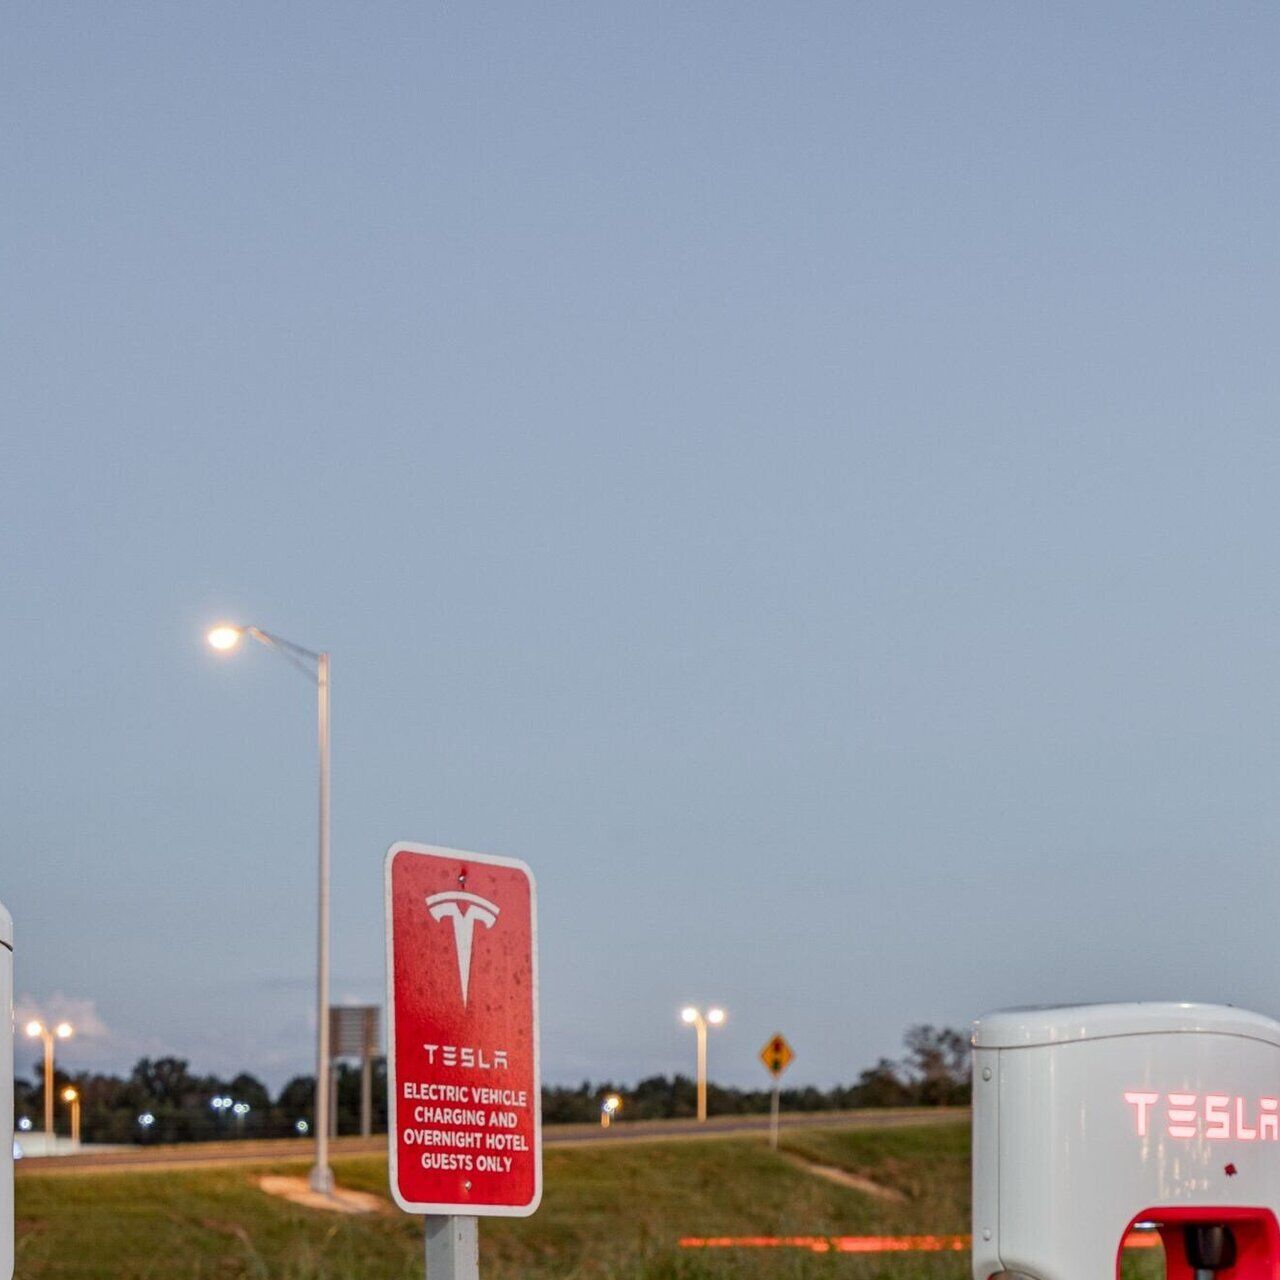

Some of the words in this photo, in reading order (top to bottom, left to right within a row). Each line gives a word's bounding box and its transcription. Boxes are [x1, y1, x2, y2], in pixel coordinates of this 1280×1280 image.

[423, 1044, 508, 1070] TESLA
[403, 1082, 469, 1102] ELECTRIC
[471, 1087, 528, 1108] VEHICLE
[414, 1106, 486, 1127] CHARGING
[488, 1111, 519, 1129] AND
[1123, 1091, 1279, 1141] TESLA
[403, 1128, 483, 1149] OVERNIGHT
[485, 1133, 529, 1152] HOTEL
[421, 1152, 474, 1171] GUESTS
[476, 1155, 513, 1173] ONLY
